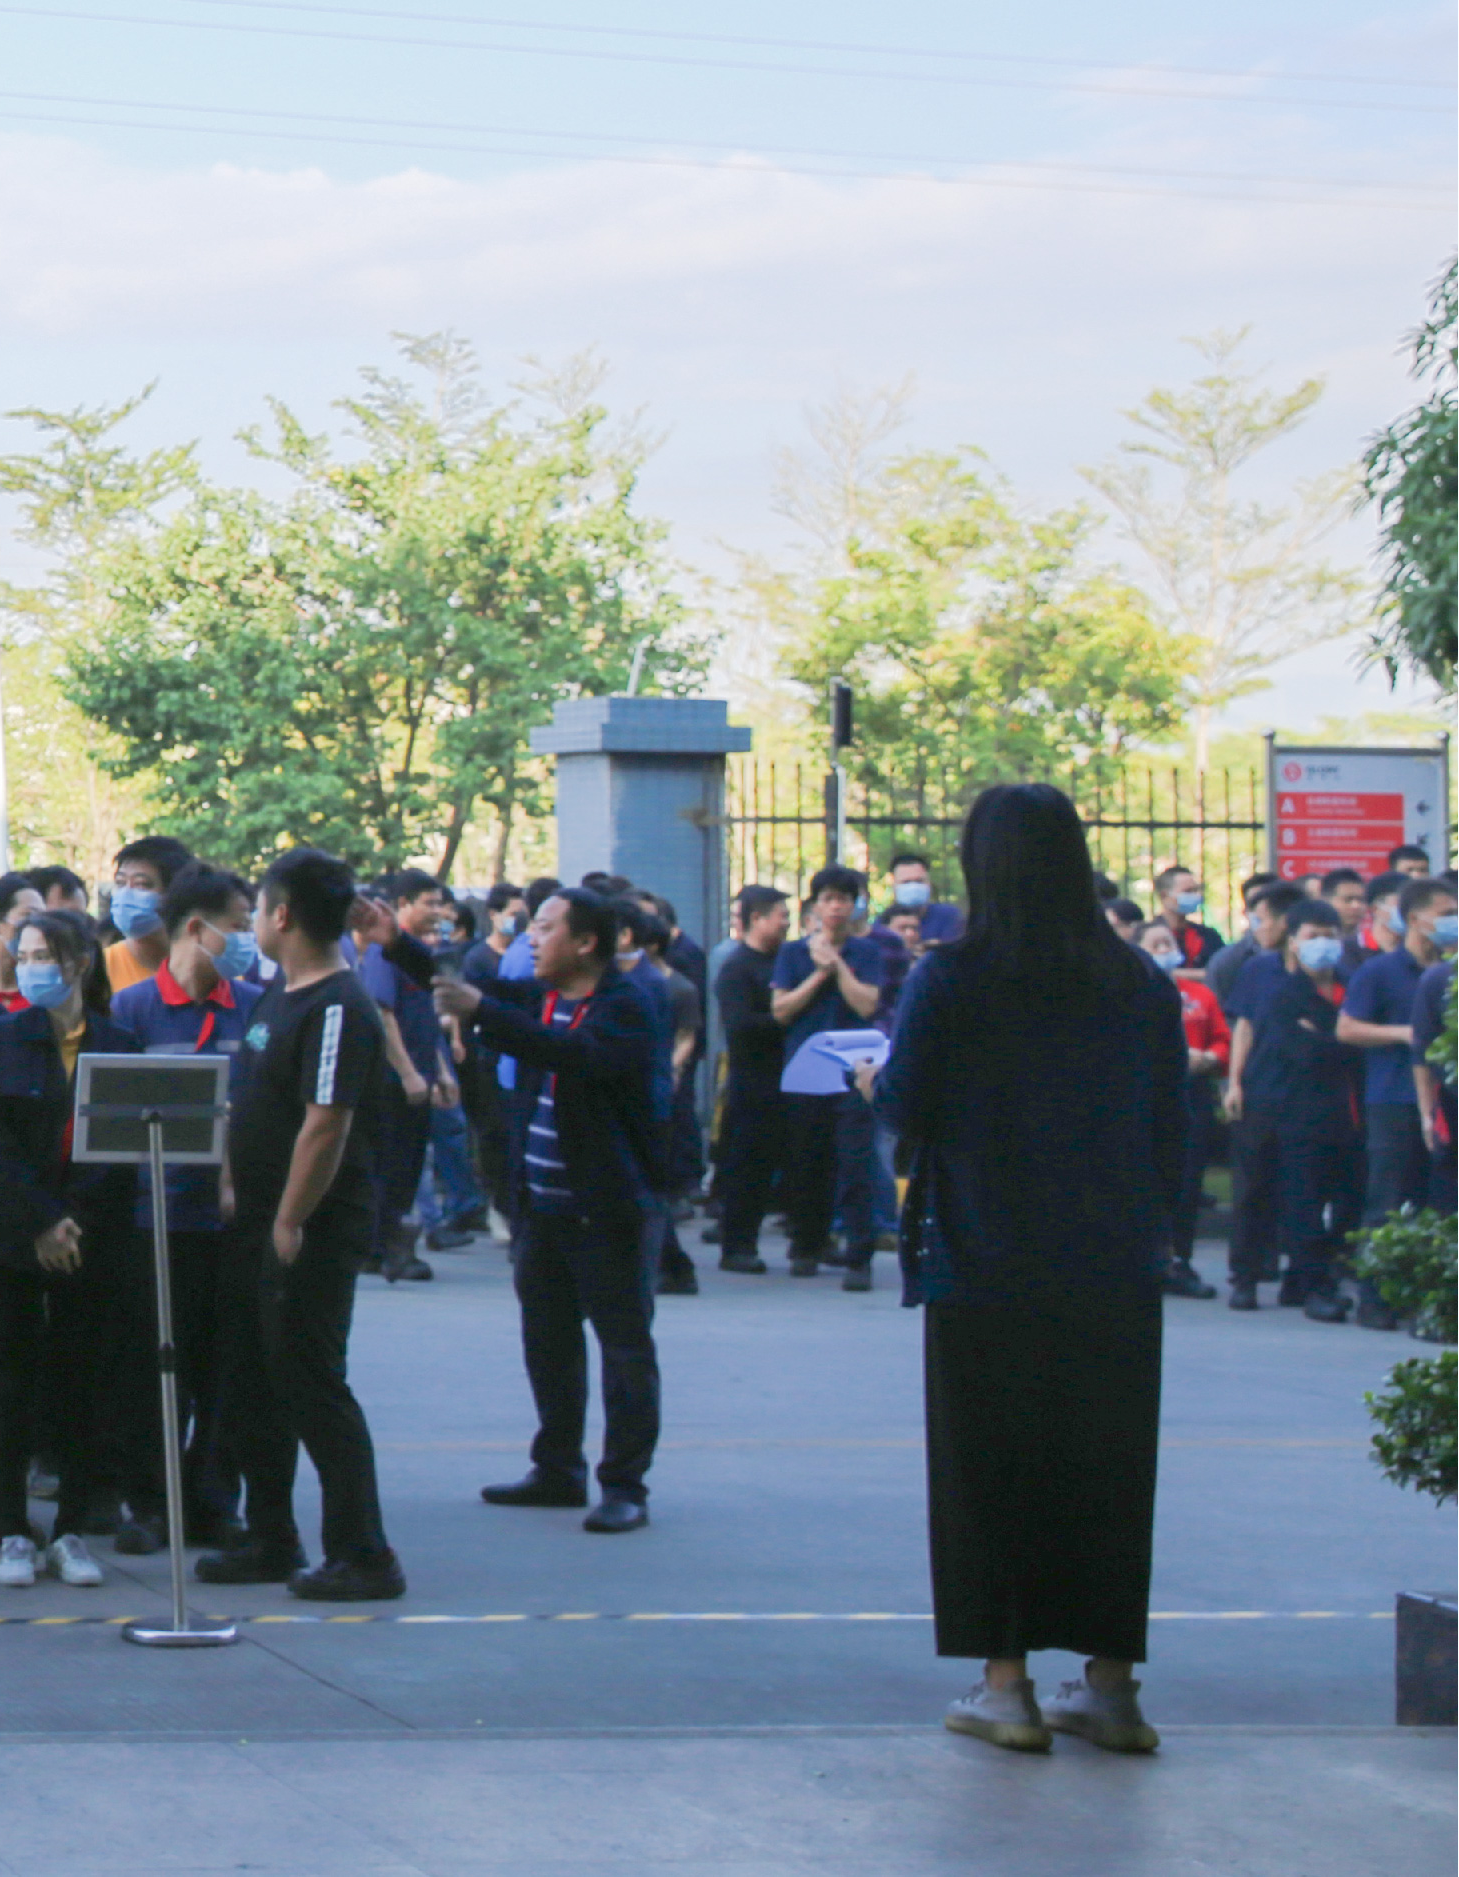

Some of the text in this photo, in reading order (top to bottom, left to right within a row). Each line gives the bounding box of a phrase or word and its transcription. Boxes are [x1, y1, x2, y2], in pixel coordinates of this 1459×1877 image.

[1281, 797, 1296, 813] A
[1282, 828, 1297, 845] B
[1282, 860, 1295, 878] C
